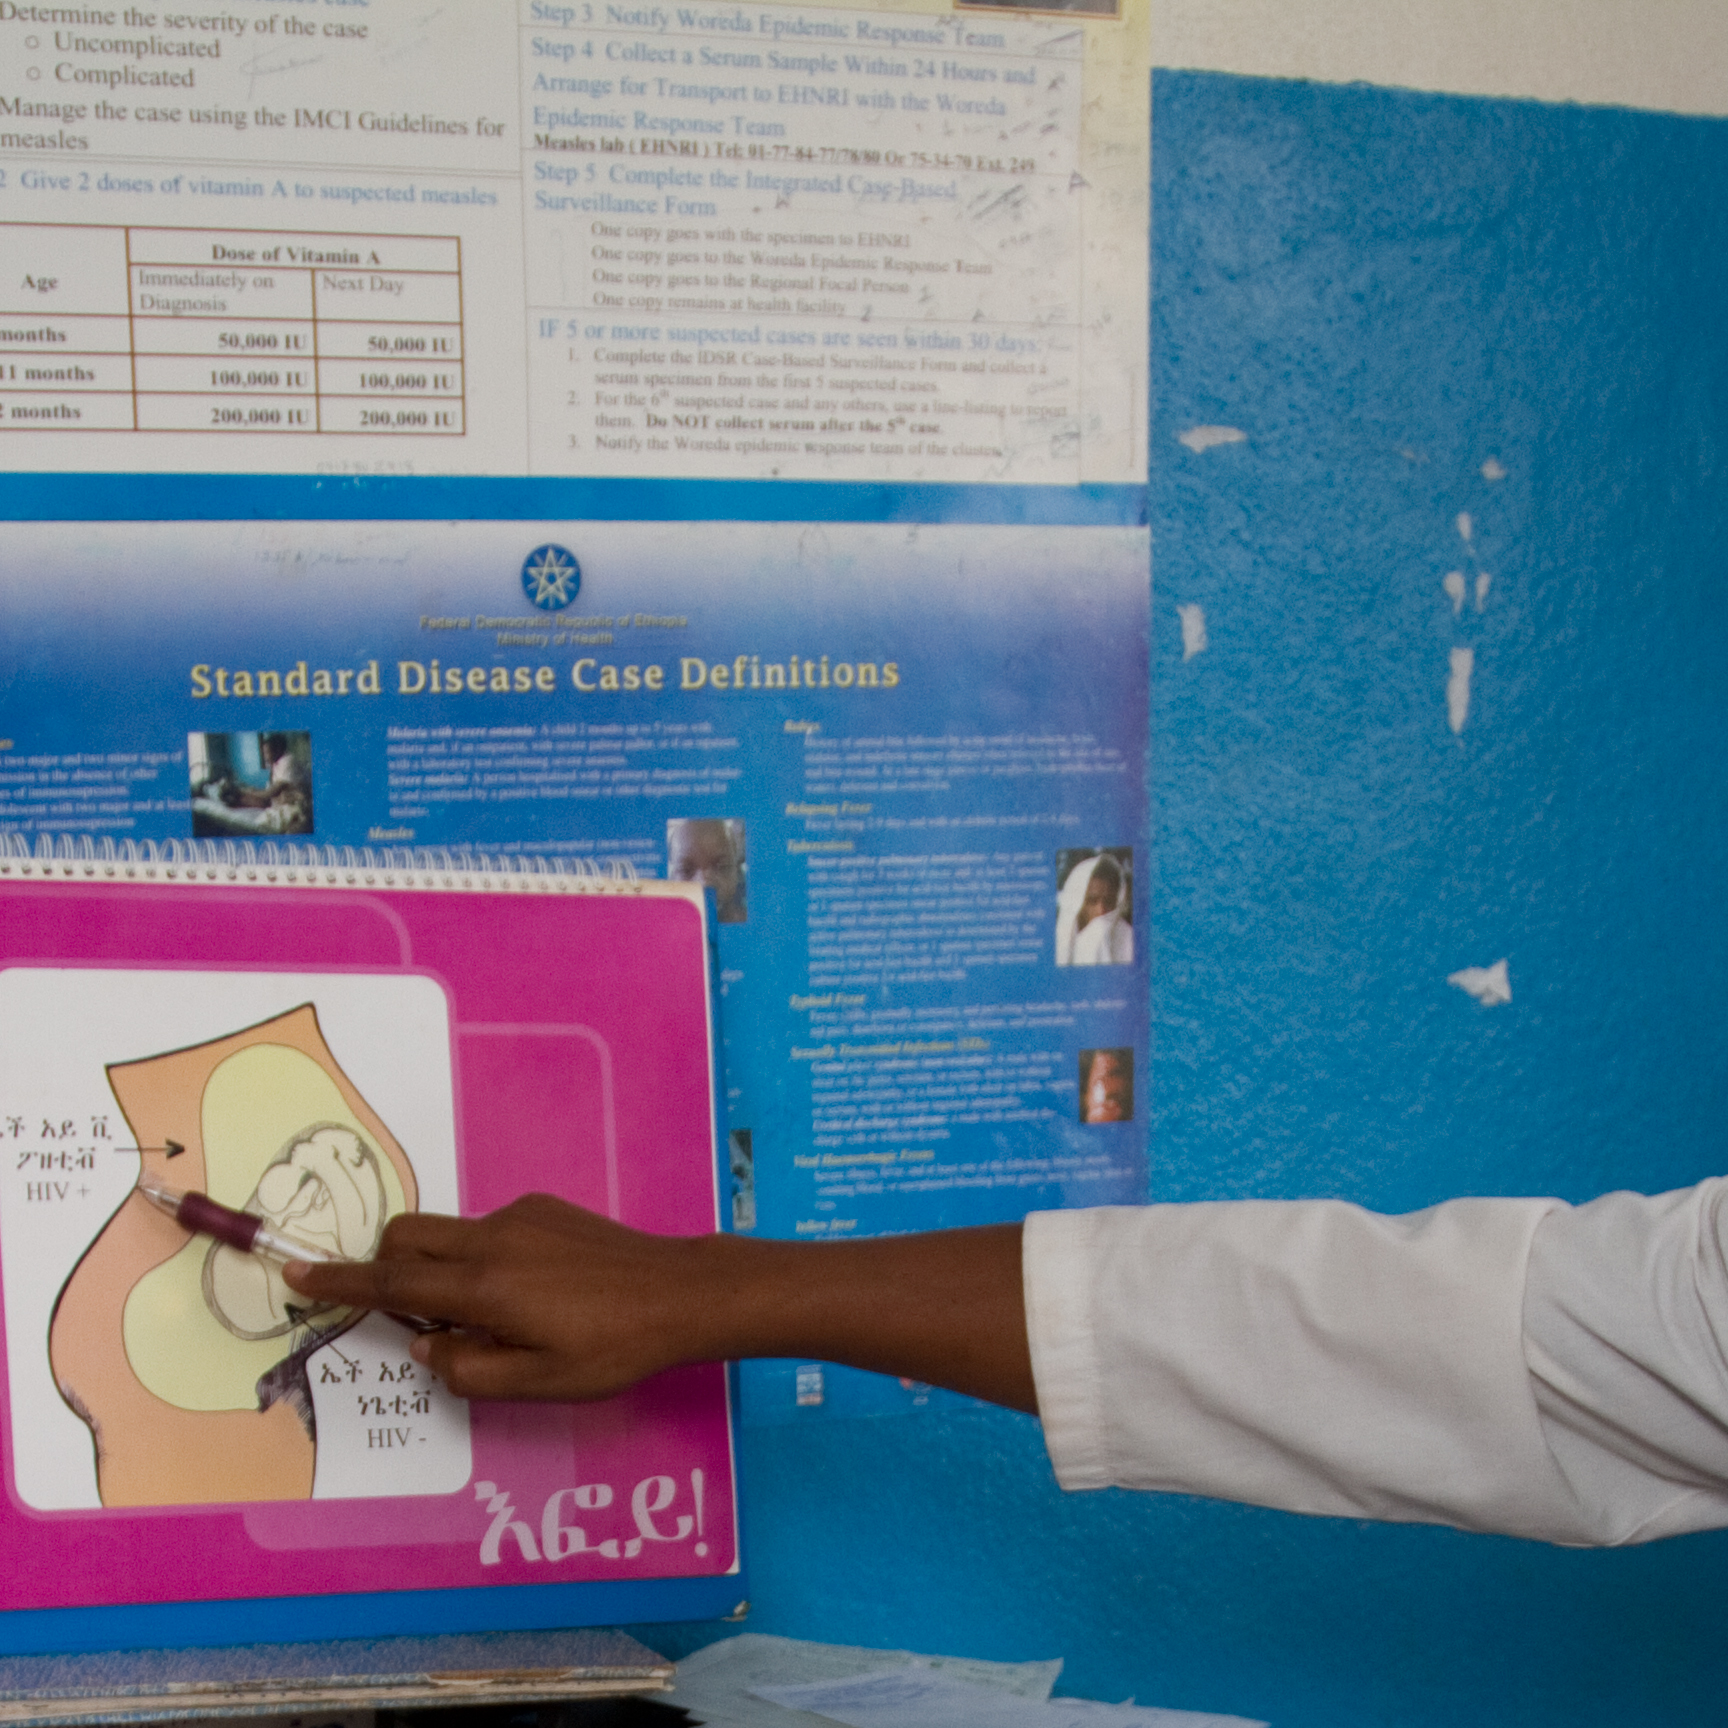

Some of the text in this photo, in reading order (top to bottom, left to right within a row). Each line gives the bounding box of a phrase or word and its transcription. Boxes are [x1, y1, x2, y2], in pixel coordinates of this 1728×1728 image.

[123, 6, 156, 28] the
[164, 15, 246, 37] severity
[253, 15, 276, 34] of
[283, 15, 316, 37] the
[322, 23, 368, 39] case
[530, 1, 1004, 48] Step 3 Notify Woreda Epidemic Response Team
[54, 31, 221, 59] Uncomplicated
[531, 37, 1035, 84] Step 4 Collect a Serum Sample Within 24 Hours and
[54, 64, 195, 89] Complicated
[534, 73, 1006, 116] Arrange for Transport to EHNRI with the Woreda
[94, 100, 127, 121] the
[134, 107, 181, 123] case
[188, 109, 247, 131] using
[253, 107, 286, 127] the
[294, 108, 351, 130] IMCI
[357, 112, 469, 135] Guidelines
[476, 116, 504, 137] for
[0, 130, 89, 150] measles
[20, 171, 70, 190] Give
[79, 171, 90, 192] 2
[96, 173, 154, 193] doses
[159, 176, 182, 194] of
[188, 181, 264, 196] vitamin
[273, 180, 287, 198] A
[294, 183, 314, 198] to
[320, 186, 416, 204] suspected
[421, 189, 497, 205] measles
[211, 244, 382, 265] Dose of Vitamin A
[25, 274, 57, 293] Age
[138, 269, 275, 290] Immediately on
[323, 273, 404, 295] Next Day
[139, 294, 227, 316] Diagnosis
[218, 333, 306, 350] 50,000 IU
[368, 336, 453, 353] 50,000 IU
[24, 366, 95, 381] months
[211, 370, 307, 387] 100,000 IU
[360, 374, 454, 390] 100,000 IU
[10, 404, 81, 419] months
[212, 408, 309, 425] 200,000 IU
[361, 410, 455, 427] 200,000 IU
[190, 656, 901, 698] Standard Disease Case Definitions
[27, 1181, 69, 1201] HIV
[367, 1427, 413, 1448] HIV
